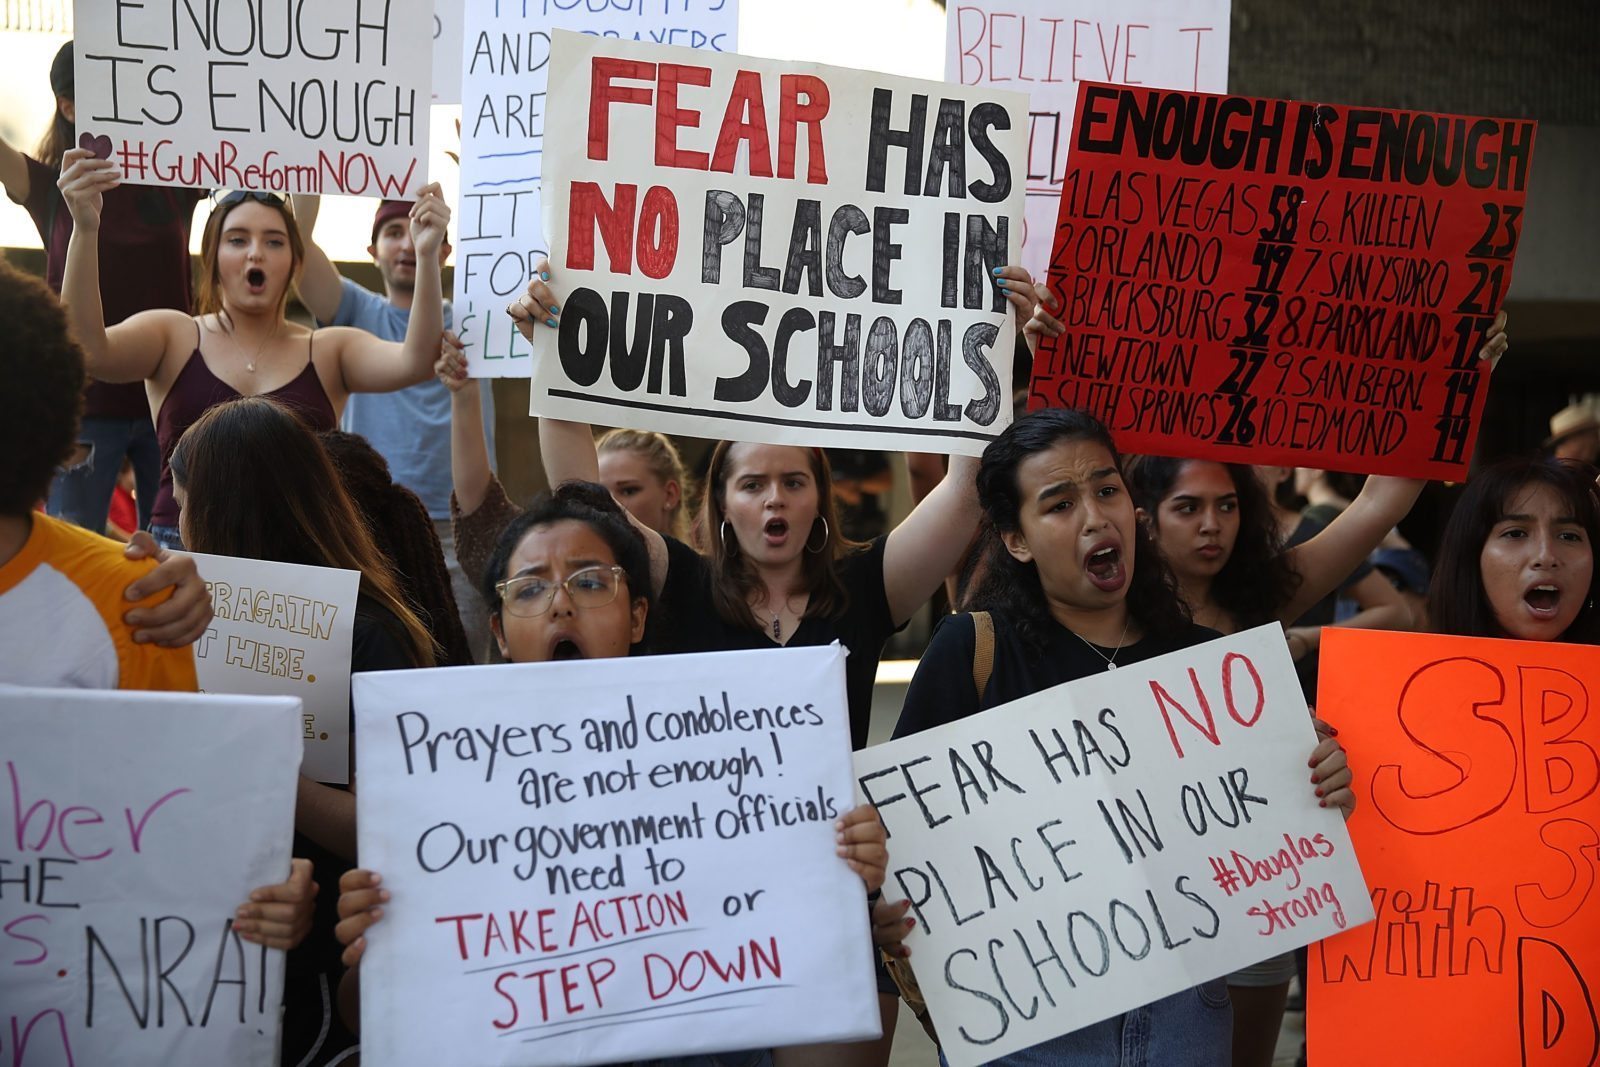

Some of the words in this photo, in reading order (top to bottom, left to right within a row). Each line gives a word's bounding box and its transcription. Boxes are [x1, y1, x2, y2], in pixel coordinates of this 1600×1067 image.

[116, 0, 391, 66] ENOUGH
[469, 31, 551, 76] AND
[957, 7, 1149, 86] BELIEVE
[84, 54, 183, 126] IS
[207, 60, 415, 147] ENOUGH
[473, 92, 547, 138] ARE
[587, 56, 831, 185] FEAR
[865, 87, 1012, 203] HAS
[1078, 87, 1287, 174] ENOUGH
[1290, 102, 1339, 180] IS
[1340, 110, 1533, 192] ENOUGH
[1155, 173, 1262, 236] VEGAS
[1259, 184, 1305, 242] 58
[1337, 191, 1443, 250] KILLEEN
[1466, 203, 1524, 257] 23
[565, 180, 680, 280] NO
[701, 189, 909, 305] PLACE
[941, 211, 1009, 314] IN
[1252, 242, 1294, 293] 49
[1232, 292, 1281, 348] 32
[1458, 262, 1504, 313] 21
[557, 286, 694, 397] OUR
[714, 300, 1004, 426] SCHOOLS
[1214, 350, 1269, 397] 27
[1453, 317, 1493, 370] 17
[1121, 386, 1225, 441] SPRINGS
[1214, 394, 1258, 445] 26
[1291, 355, 1355, 401] SAN
[1353, 363, 1428, 412] BERN.
[1443, 373, 1481, 419] 14
[1431, 419, 1472, 464] 14
[225, 635, 317, 682] HERE.
[396, 710, 572, 783] Prayers
[580, 695, 638, 753] and
[645, 691, 824, 743] condolences
[859, 740, 1027, 838] FEAR
[1028, 707, 1131, 784] HAS
[1148, 651, 1265, 759] NO
[517, 767, 577, 809] are
[583, 759, 641, 797] not
[416, 822, 508, 873] Our
[512, 802, 705, 881] government
[714, 785, 838, 840] officials
[894, 819, 1083, 936] PLACE
[1097, 789, 1165, 865] IN
[1180, 767, 1268, 836] OUR
[1208, 832, 1335, 897] #Douglas
[545, 854, 626, 895] need
[645, 847, 686, 886] to
[435, 909, 557, 961] TAKE
[568, 890, 690, 947] ACTION
[722, 888, 766, 917] or
[85, 915, 270, 1035] NRA!
[492, 957, 616, 1029] STEP
[643, 936, 783, 1001] DOWN
[943, 875, 1220, 1046] SCHOOLS
